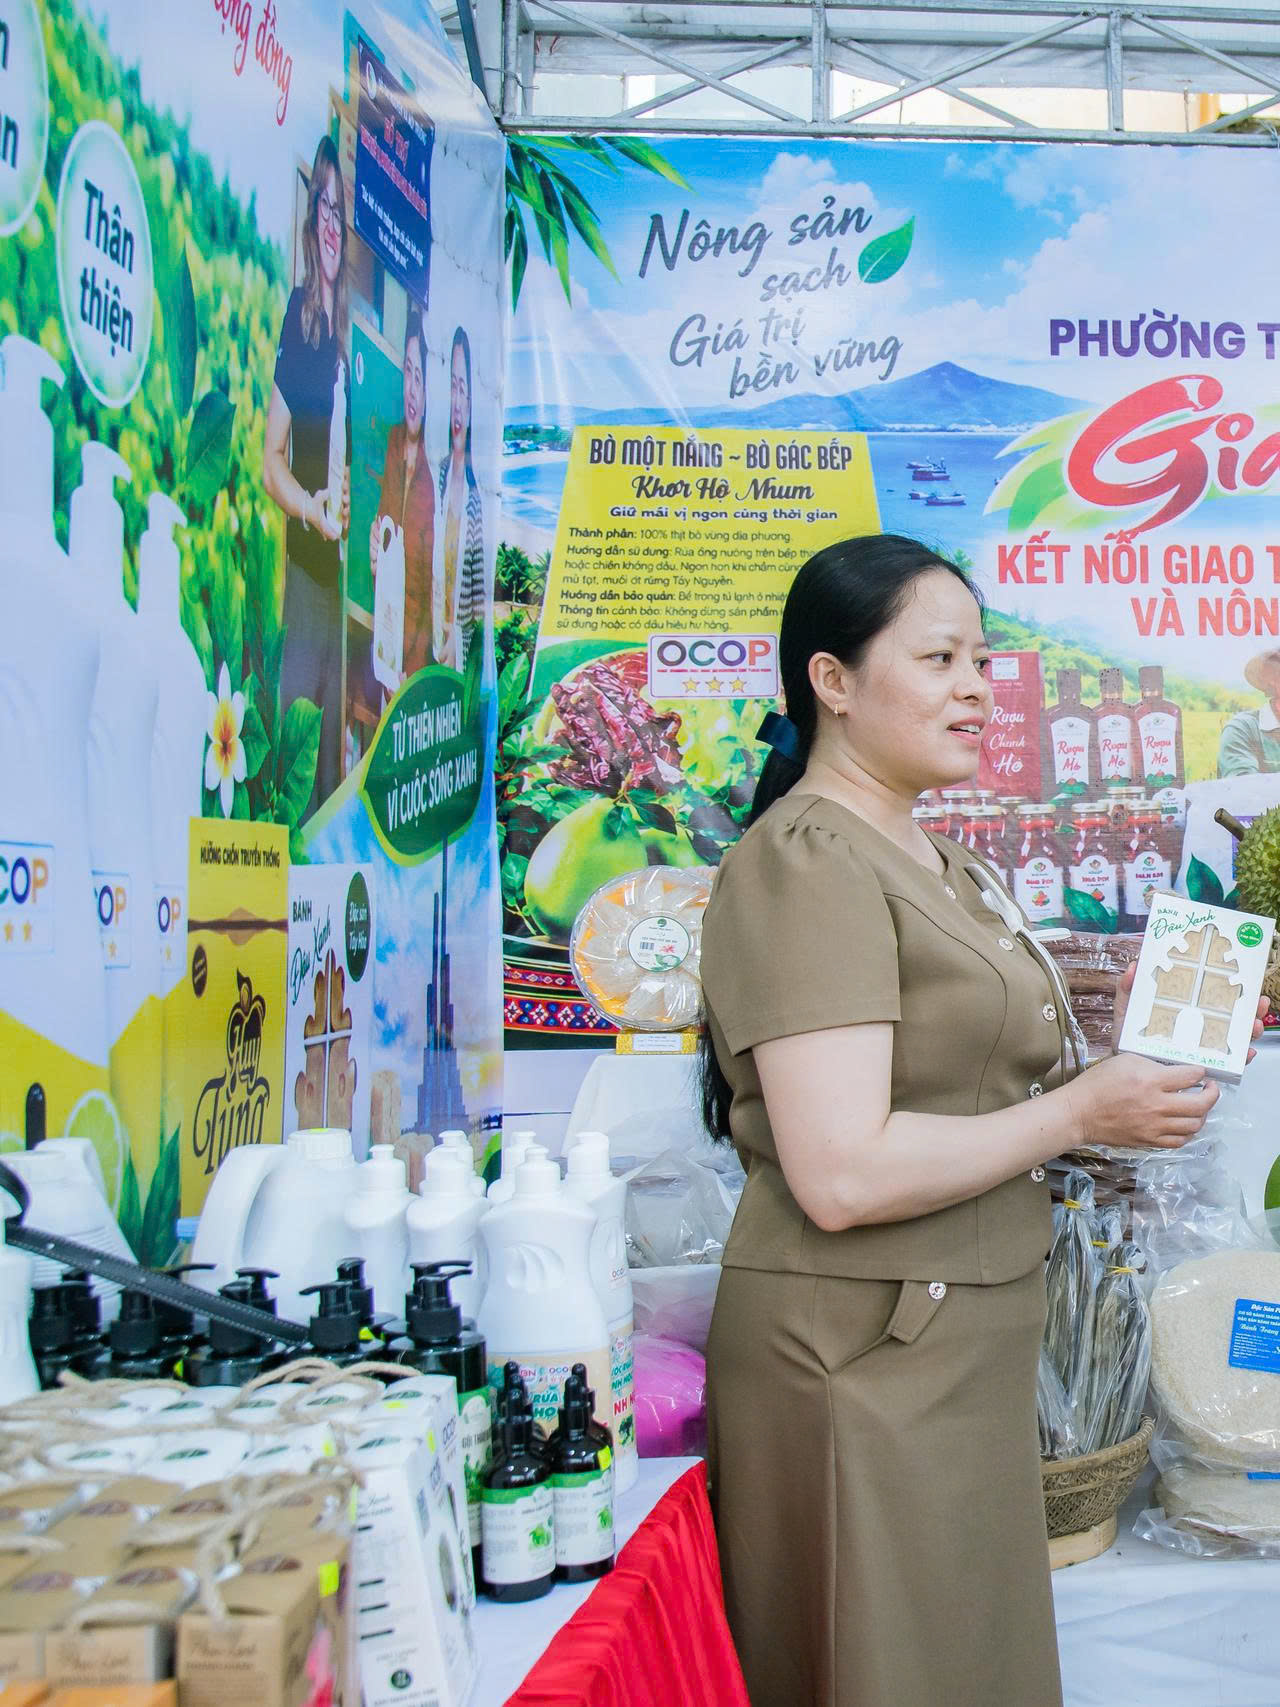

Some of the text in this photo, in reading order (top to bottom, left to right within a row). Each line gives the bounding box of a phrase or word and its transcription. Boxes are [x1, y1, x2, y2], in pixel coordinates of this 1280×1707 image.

[84, 179, 134, 275] Thân
[638, 195, 872, 279] Nông sản
[760, 247, 851, 303] sạch
[80, 266, 133, 357] thiện
[669, 307, 806, 367] Giá trị
[1049, 308, 1245, 359] PHƯỜNG
[730, 335, 903, 399] bền vững
[590, 433, 852, 471] BÒ MỘT NẮNG BÒ GÁC BẾP
[610, 506, 637, 517] Giữ
[674, 509, 687, 520] vị
[692, 510, 728, 521] ngon
[733, 508, 768, 522] cùng
[772, 508, 801, 519] thời
[806, 510, 837, 522] gian
[999, 532, 1071, 584] KẾT
[1163, 542, 1255, 585] GIAO
[1130, 587, 1184, 636] VÀ
[657, 640, 771, 667] OCOP
[393, 692, 461, 763] TỪ THIÊN NHIÊN
[388, 748, 477, 832] VÌ CUỘC SỐNG XANH
[293, 895, 312, 922] BÁNH
[1150, 909, 1216, 940] Đậu Xanh
